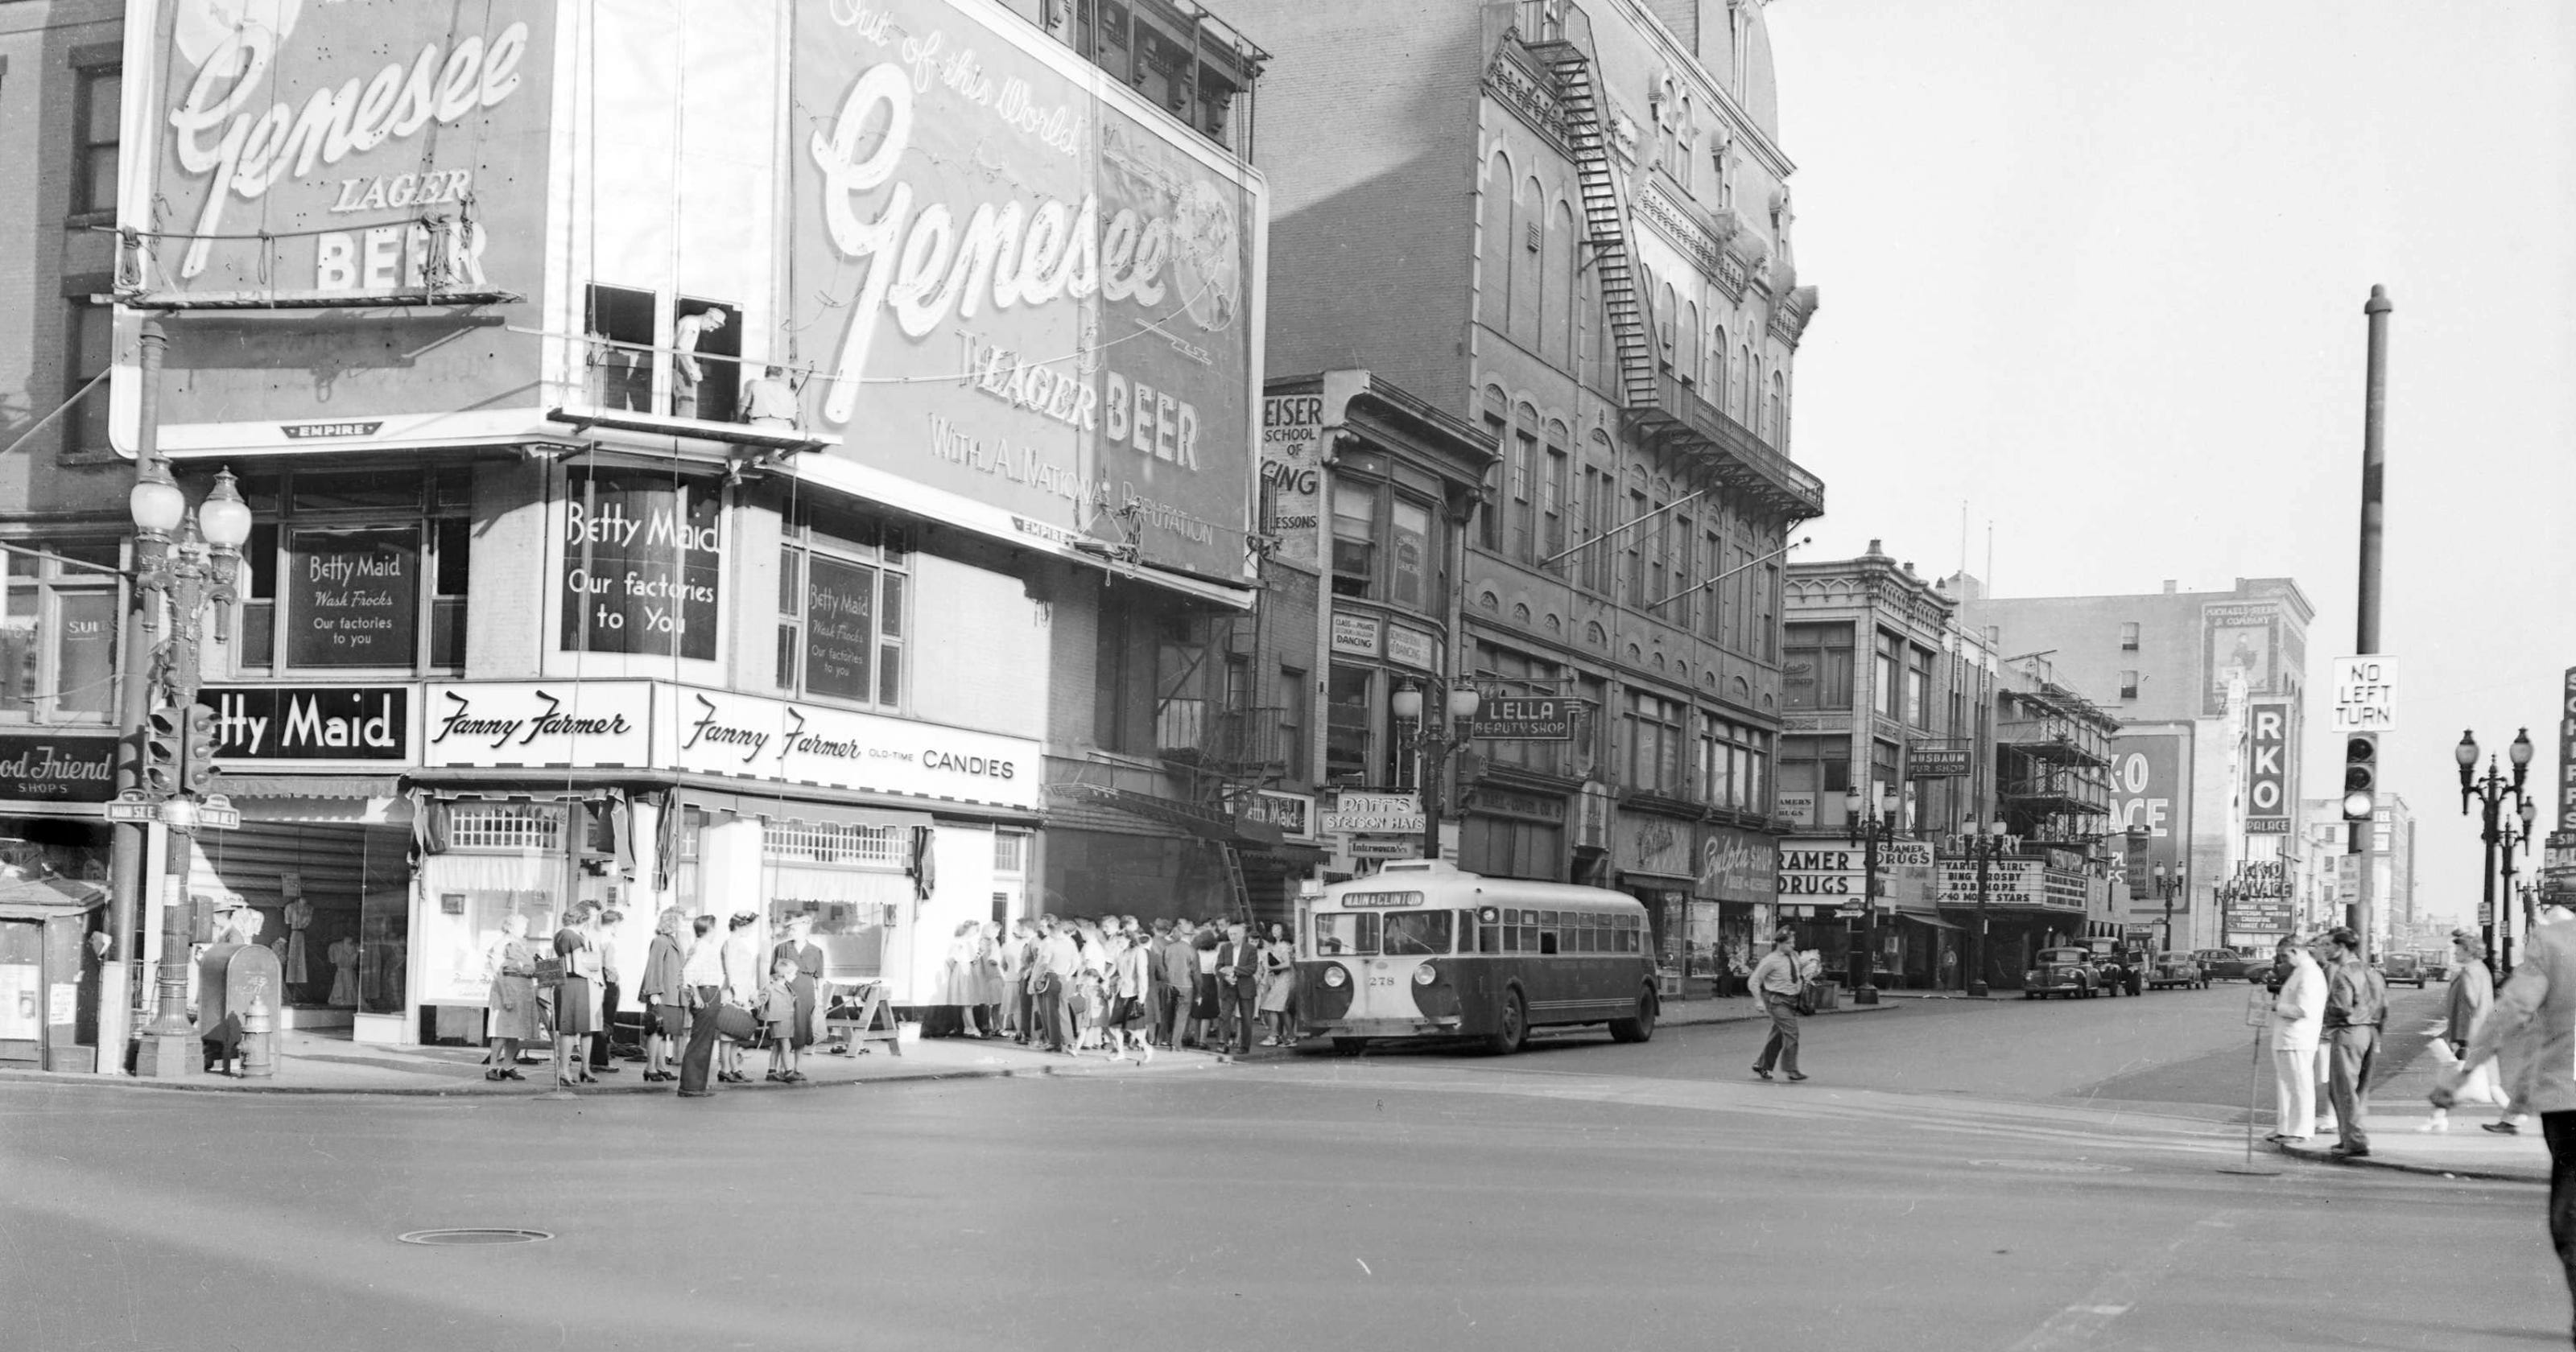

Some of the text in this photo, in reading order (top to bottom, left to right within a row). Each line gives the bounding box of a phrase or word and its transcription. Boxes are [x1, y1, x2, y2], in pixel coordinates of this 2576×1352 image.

[901, 30, 943, 94] of
[940, 48, 993, 107] this
[168, 21, 529, 278] Genesee
[330, 168, 473, 213] LAGER
[811, 61, 1169, 424] Genesee
[317, 221, 487, 291] BEER
[976, 344, 1200, 472] LAGER BEER
[1263, 398, 1323, 427] EISER
[299, 424, 365, 437] EMPIRE
[1264, 427, 1316, 442] SCHOOL
[928, 411, 983, 468] WITH
[988, 439, 1013, 480] A
[1286, 443, 1303, 456] OF
[1260, 460, 1317, 496] CING
[567, 501, 721, 554] Betty Maid
[1275, 516, 1317, 529] ESSONS
[1023, 522, 1071, 543] EMPIRE
[309, 553, 402, 587] Betty Maid
[568, 568, 713, 603] Our factories
[315, 589, 393, 608] Wash Frocks
[809, 583, 869, 620] Betty Maid
[313, 616, 393, 629] Our factories
[597, 604, 686, 633] to You
[333, 632, 371, 648] to you
[1336, 634, 1373, 649] DANCING
[811, 644, 864, 665] Our factories
[824, 662, 850, 678] to you
[2351, 662, 2380, 682] NO
[2340, 685, 2392, 703] LEFT
[431, 690, 633, 749] Fanny Farmer
[1490, 702, 1554, 719] LELLA
[2335, 707, 2390, 725] TURN
[213, 692, 395, 755] tty Maid
[682, 693, 861, 765] Fanny Farmer
[1475, 722, 1566, 734] BEAUTY SHOP
[0, 745, 112, 781] od Friend
[868, 748, 1015, 781] OLD-TIME CANDIES
[1910, 765, 1965, 773] FUR SHOP
[2252, 711, 2283, 809] RKO
[18, 782, 68, 793] SHOPS
[1327, 814, 1426, 830] STETSON HATS
[2108, 798, 2169, 837] ACE
[2246, 819, 2289, 831] PALACE
[1751, 844, 1772, 872] SHOP
[1879, 844, 1926, 853] CRAMER
[1876, 852, 1930, 865] DRUGS
[1939, 862, 1988, 871] "VARIE
[1778, 876, 1849, 895] DRUGS
[1948, 872, 2021, 882] BING ROSBY
[1951, 882, 1977, 891] BOB
[1963, 892, 1991, 901] MOE
[1996, 893, 2031, 902] STARS
[2227, 880, 2293, 898] PALACE
[1344, 893, 1368, 906] MAIN
[1377, 892, 1422, 906] CLINTON
[1369, 976, 1395, 987] 278
